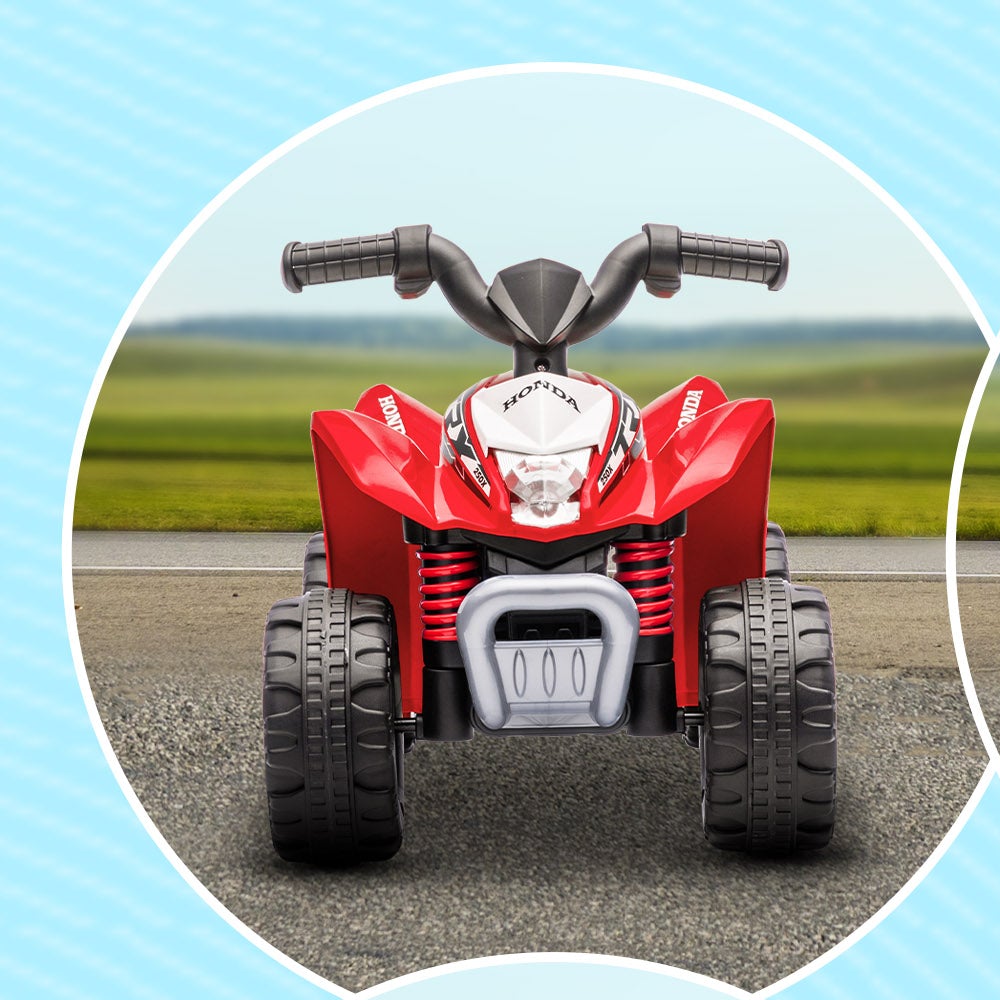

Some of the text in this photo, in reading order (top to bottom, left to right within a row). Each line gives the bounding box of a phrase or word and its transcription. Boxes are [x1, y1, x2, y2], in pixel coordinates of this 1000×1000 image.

[502, 380, 581, 414] HONDA
[676, 390, 704, 430] ONDA
[473, 467, 487, 488] 250X
[600, 464, 613, 486] 250X
